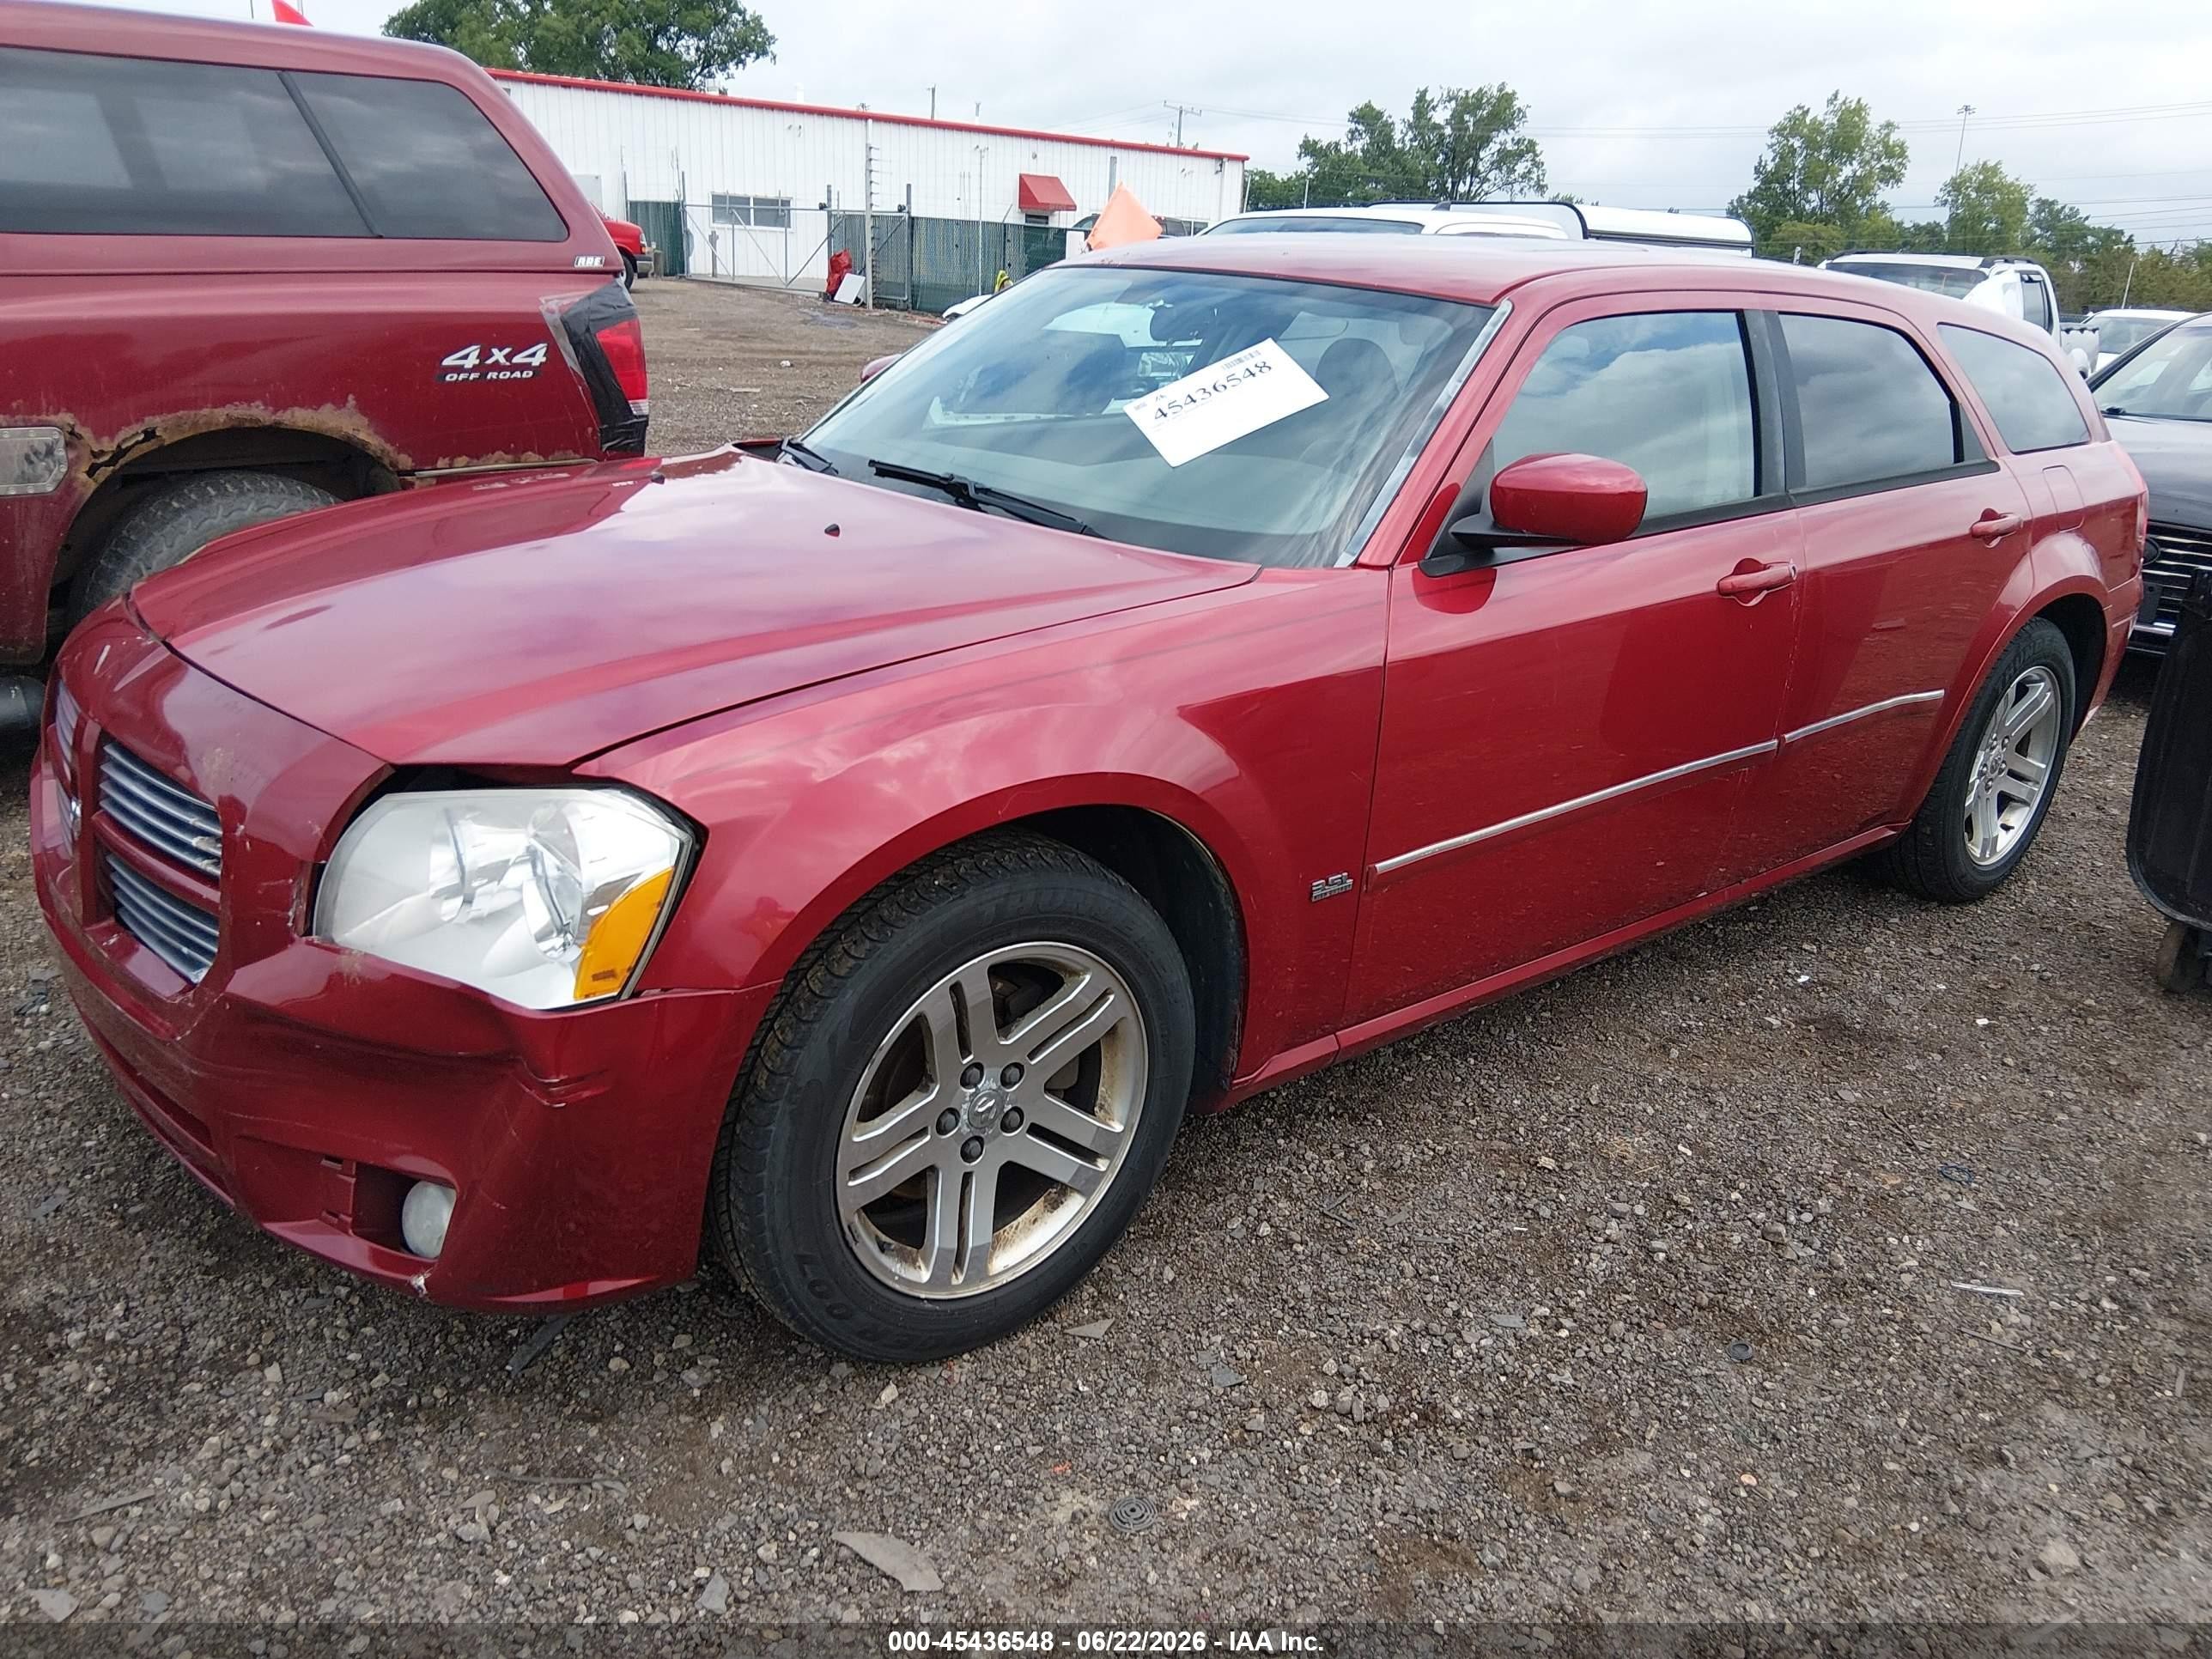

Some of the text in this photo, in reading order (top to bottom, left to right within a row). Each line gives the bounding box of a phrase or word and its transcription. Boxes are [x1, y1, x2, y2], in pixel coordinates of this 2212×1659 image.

[445, 370, 533, 381] OFF ROAD
[1154, 361, 1273, 420] 45436548
